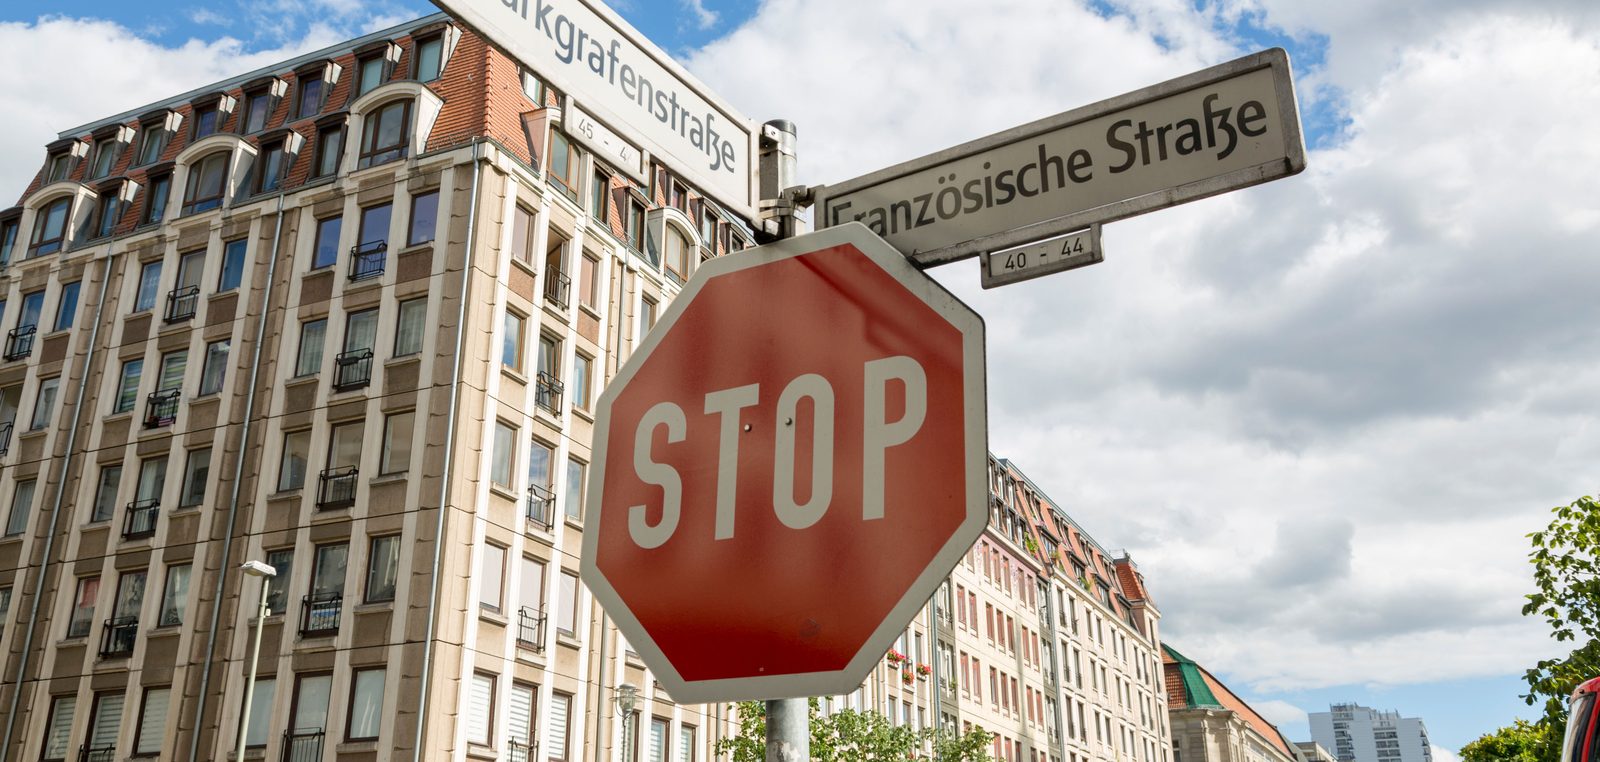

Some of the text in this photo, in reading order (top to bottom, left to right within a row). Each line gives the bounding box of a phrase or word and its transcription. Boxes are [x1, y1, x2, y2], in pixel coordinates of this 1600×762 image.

[578, 119, 593, 139] 45
[1106, 93, 1267, 174] Straße
[1005, 252, 1026, 270] 40
[1061, 237, 1084, 256] 44
[628, 355, 928, 550] STOP
